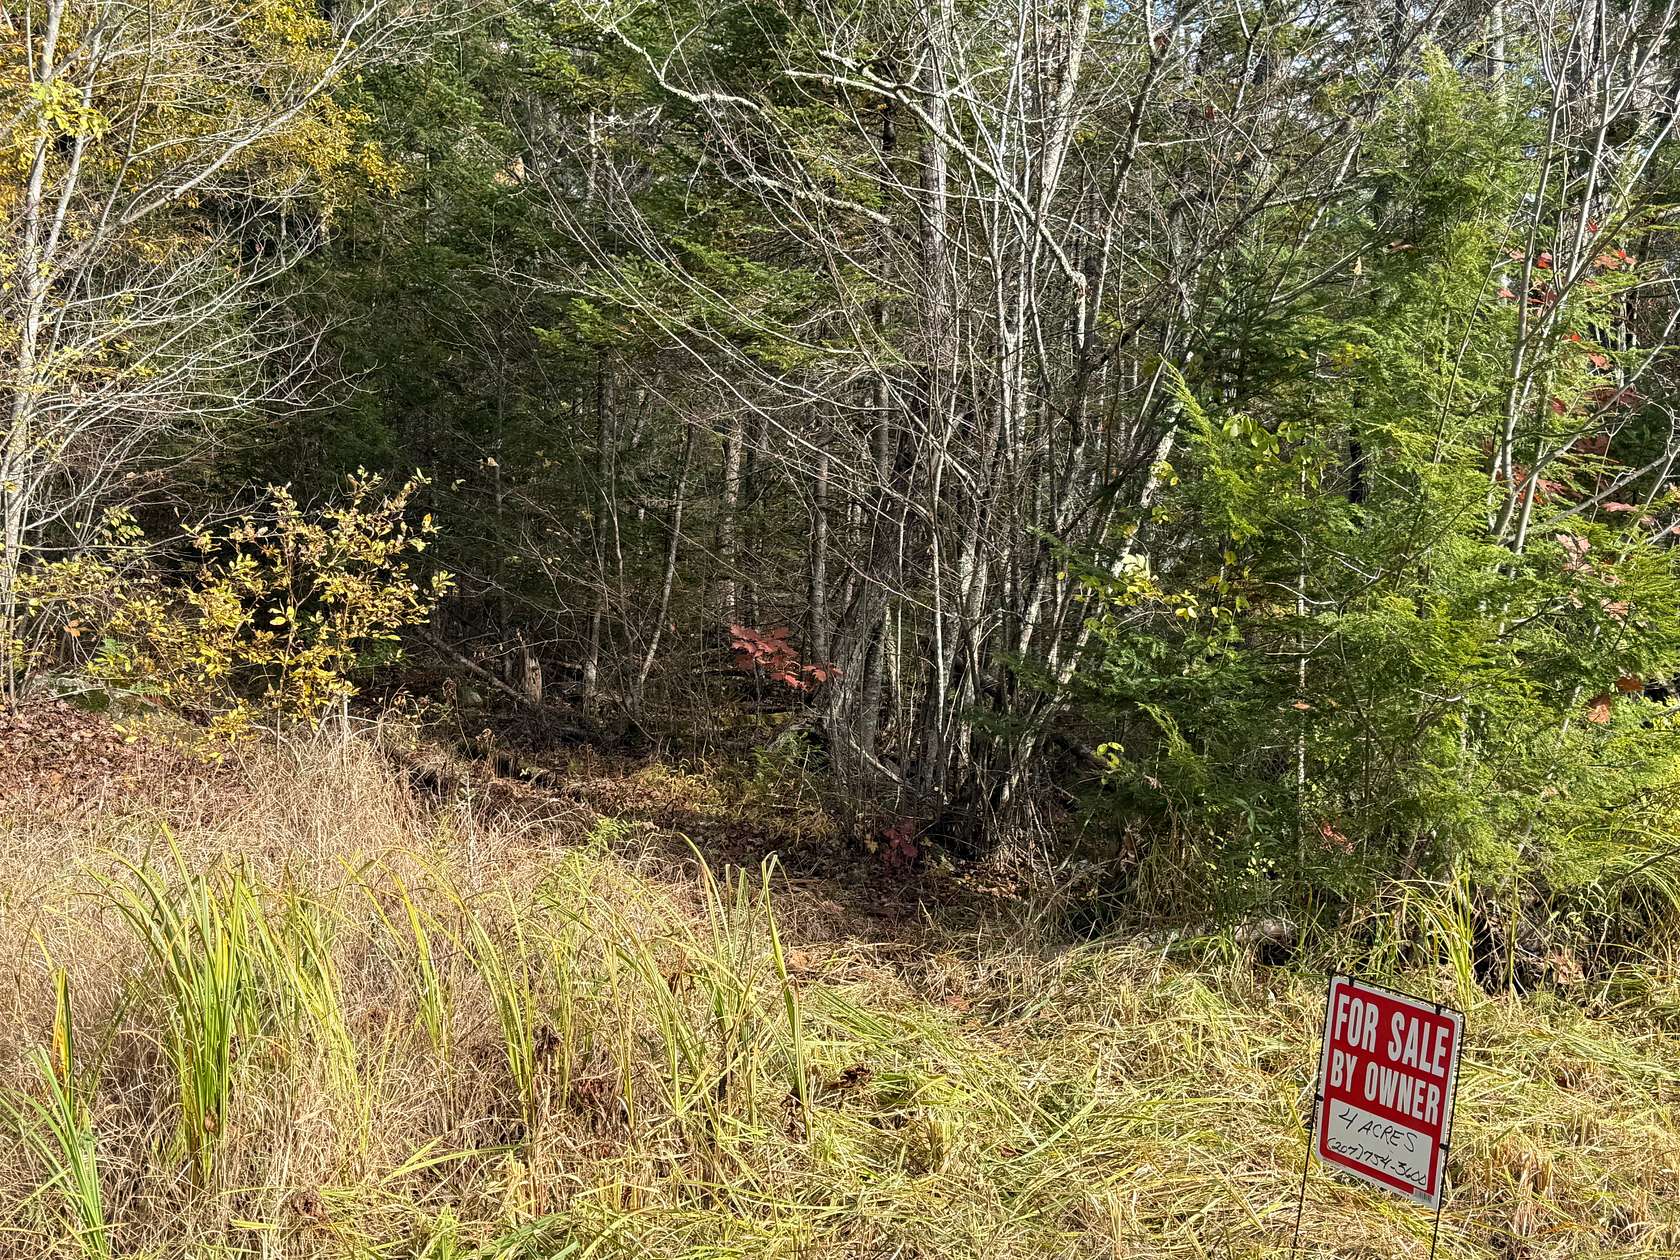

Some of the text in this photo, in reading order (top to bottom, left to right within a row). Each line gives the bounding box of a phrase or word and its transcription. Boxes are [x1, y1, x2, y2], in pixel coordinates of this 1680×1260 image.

[1334, 993, 1449, 1078] FOR SALE
[1330, 1049, 1440, 1126] BY OWNER
[1338, 1108, 1418, 1152] 4 ACRES
